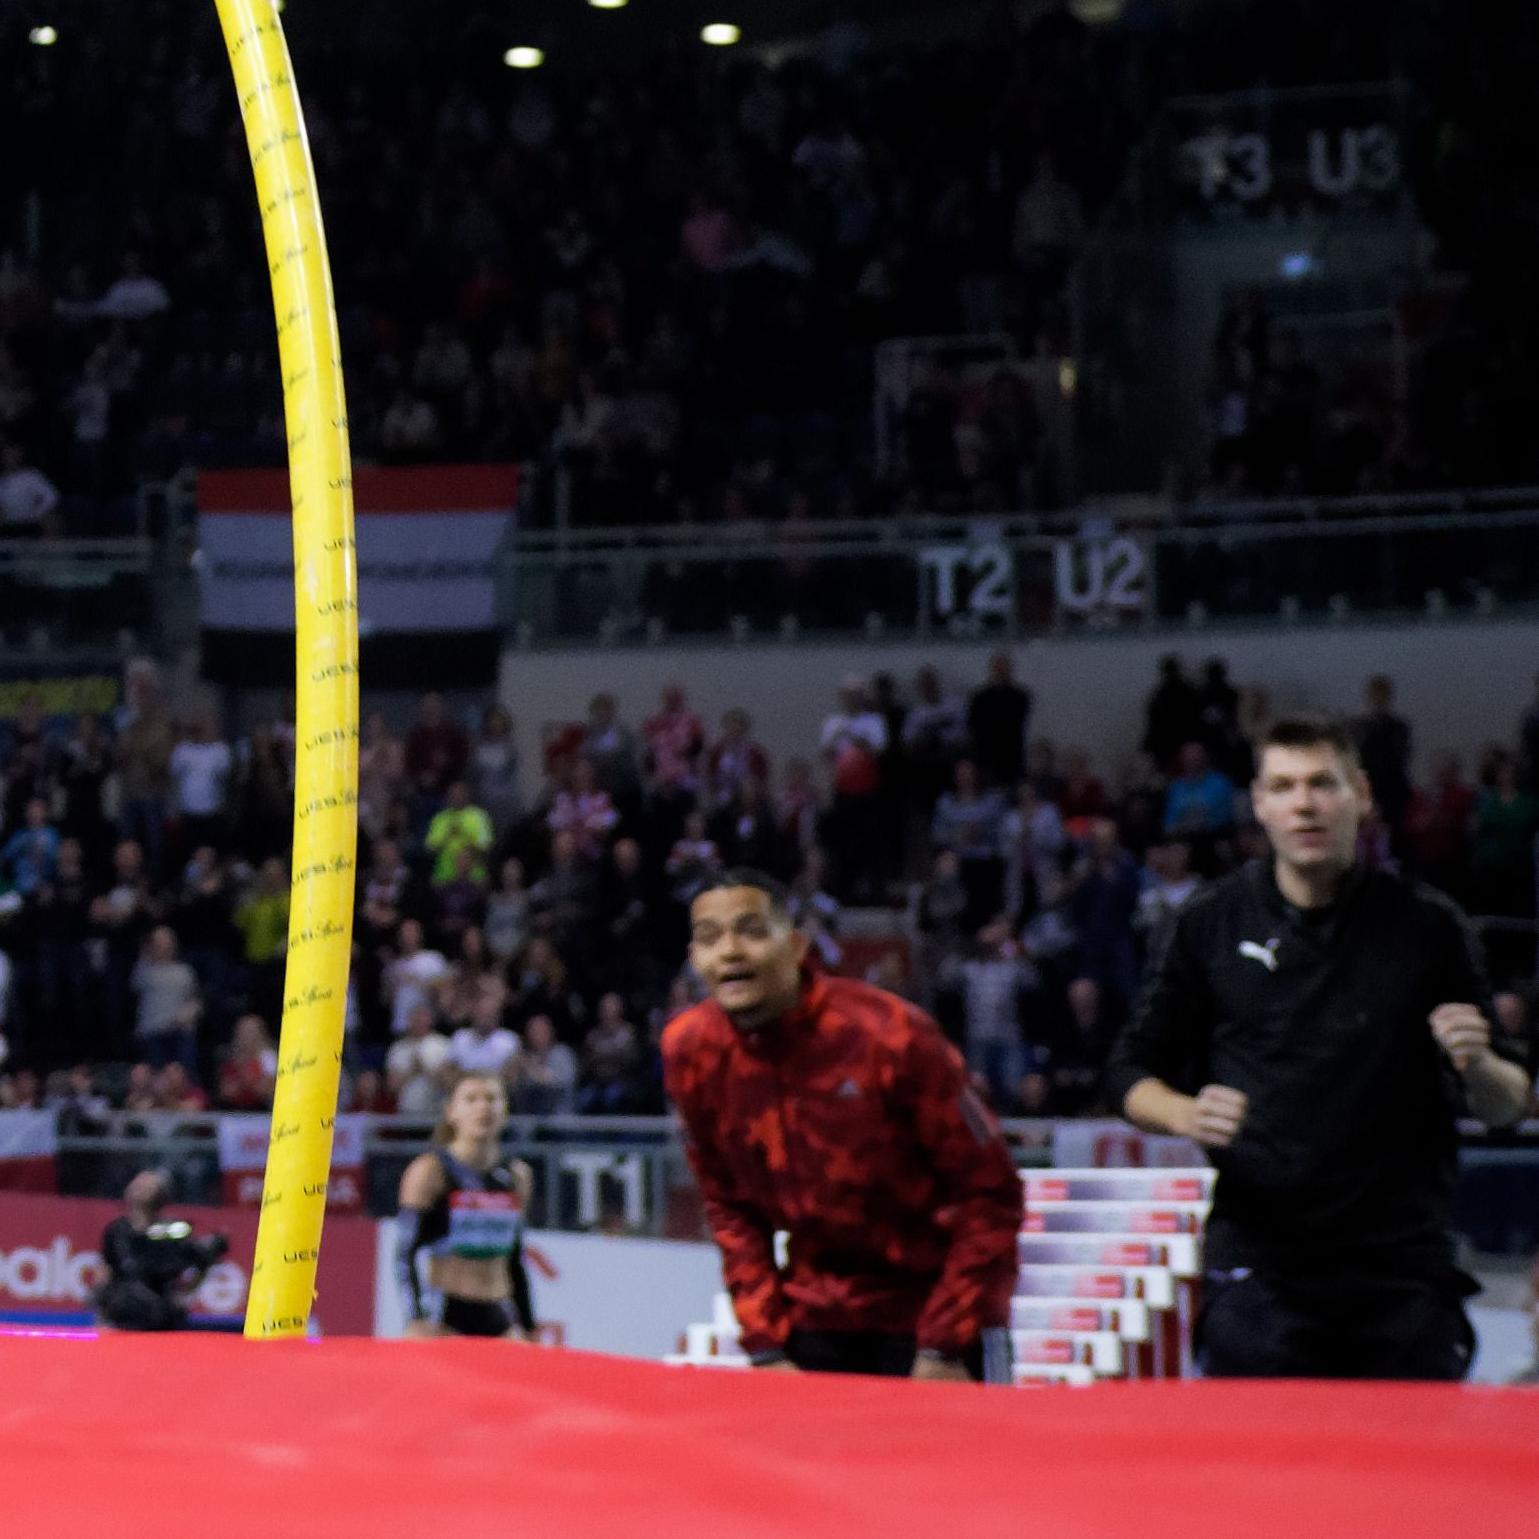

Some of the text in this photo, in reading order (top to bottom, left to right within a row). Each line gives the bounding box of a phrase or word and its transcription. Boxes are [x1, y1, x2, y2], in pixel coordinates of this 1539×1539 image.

[1308, 127, 1401, 194] U3
[920, 537, 1144, 614] T2 U2
[562, 1151, 647, 1228] T1
